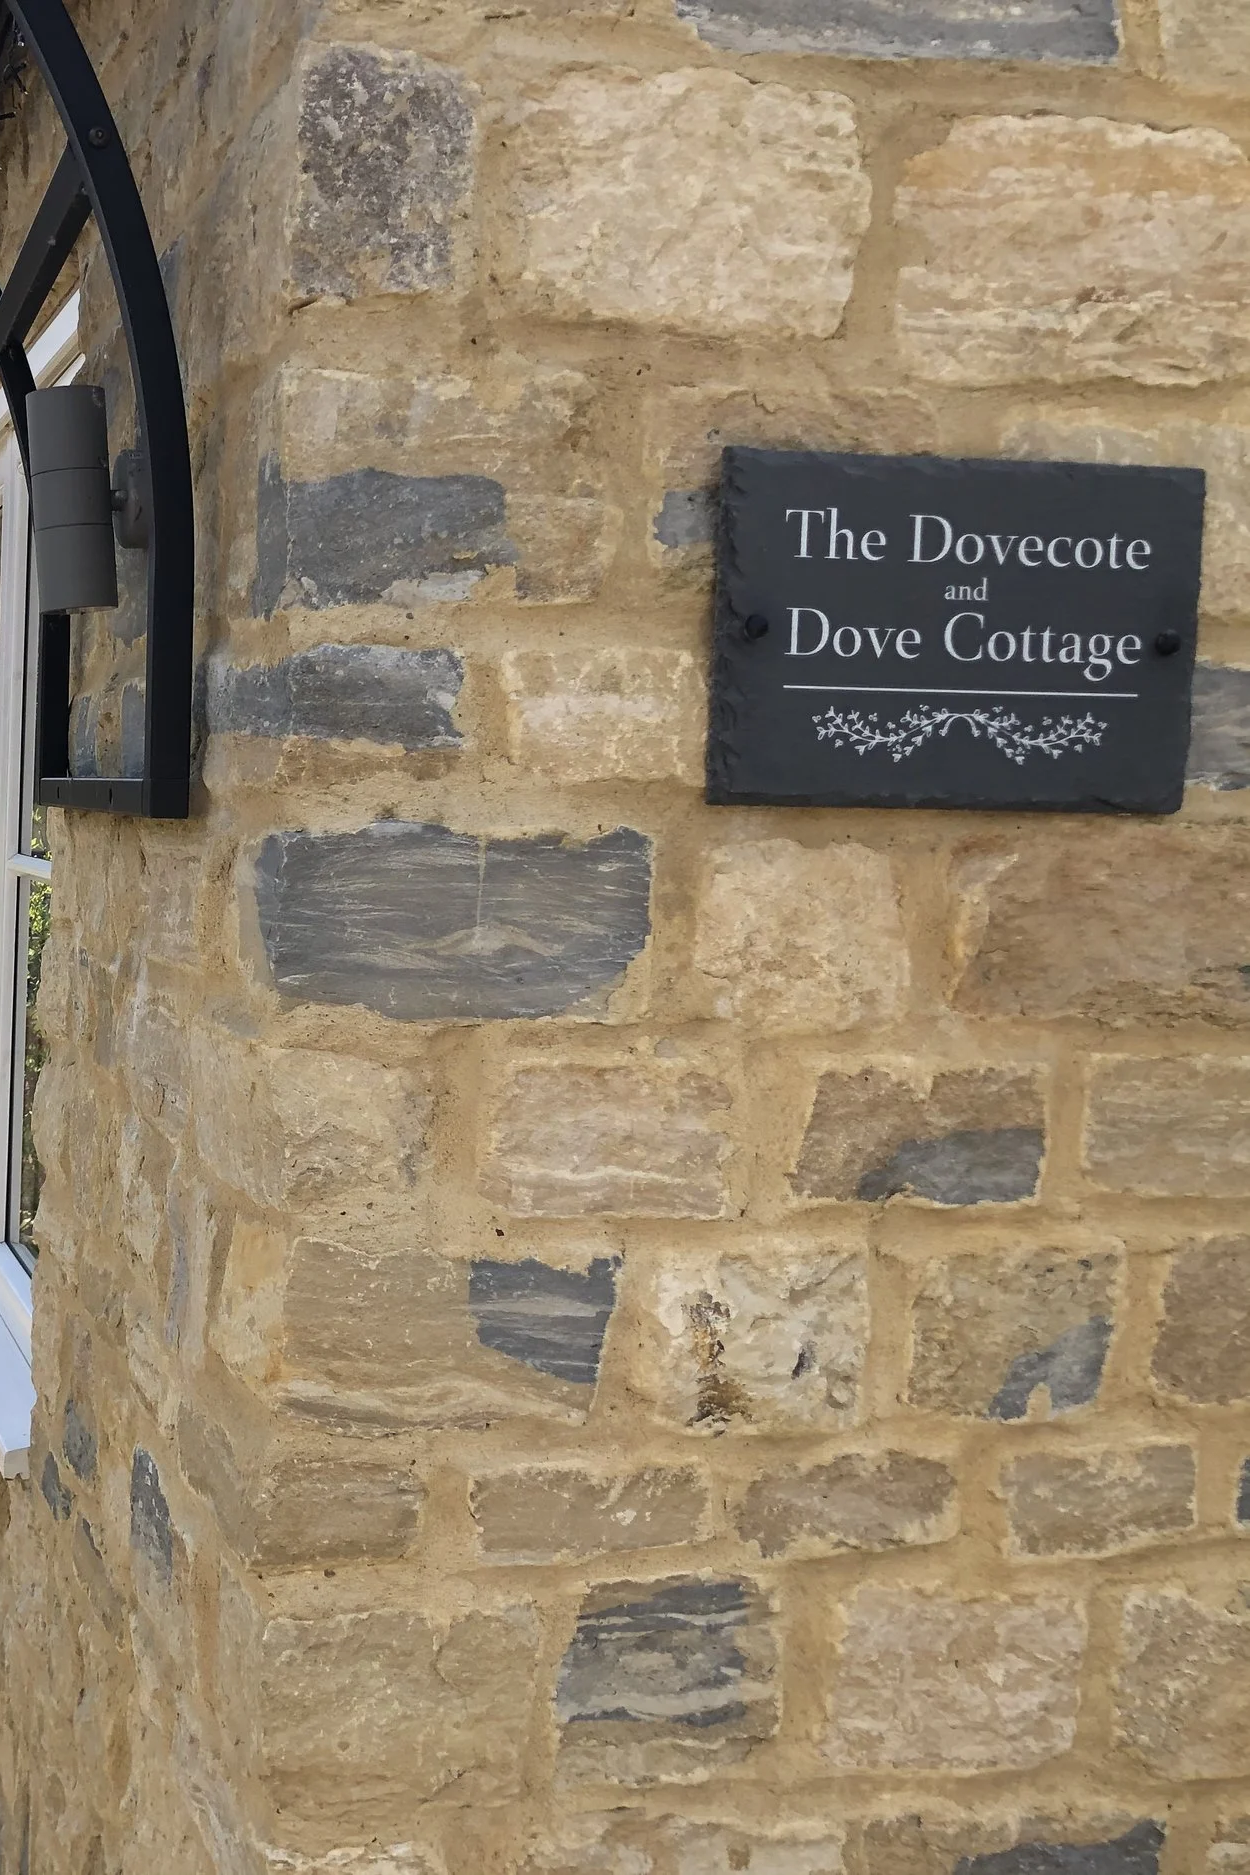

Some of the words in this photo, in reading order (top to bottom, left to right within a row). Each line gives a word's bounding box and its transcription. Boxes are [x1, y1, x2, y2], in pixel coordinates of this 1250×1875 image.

[785, 507, 887, 561] The
[907, 514, 1152, 570] Dovecote
[944, 577, 989, 601] and
[783, 607, 922, 660] Dove
[943, 612, 1143, 682] Cottage
